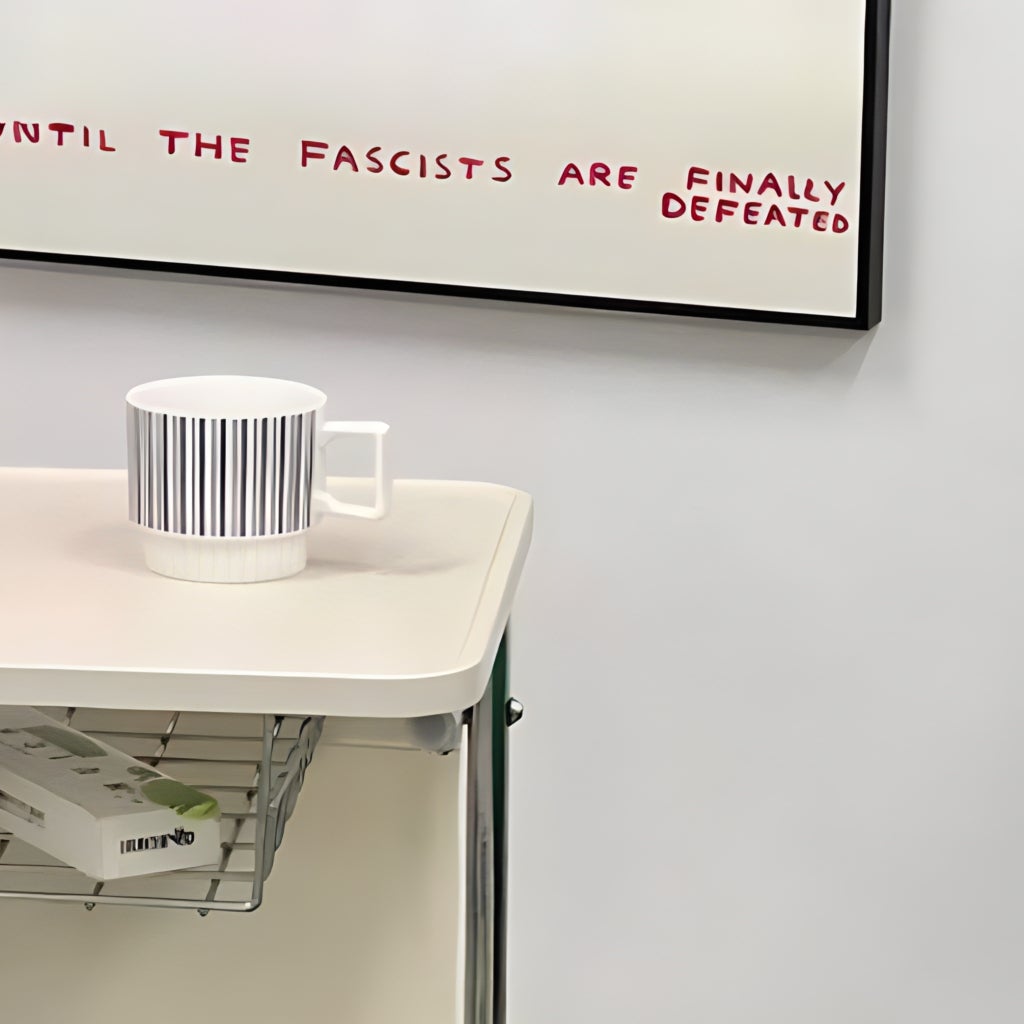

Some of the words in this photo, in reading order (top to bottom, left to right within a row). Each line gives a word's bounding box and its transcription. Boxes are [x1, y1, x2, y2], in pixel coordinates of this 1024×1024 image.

[158, 128, 251, 164] THE
[300, 138, 513, 183] FASCISTS
[558, 161, 640, 190] ARE
[685, 165, 847, 207] FINALLY
[661, 191, 850, 234] DEFEATED
